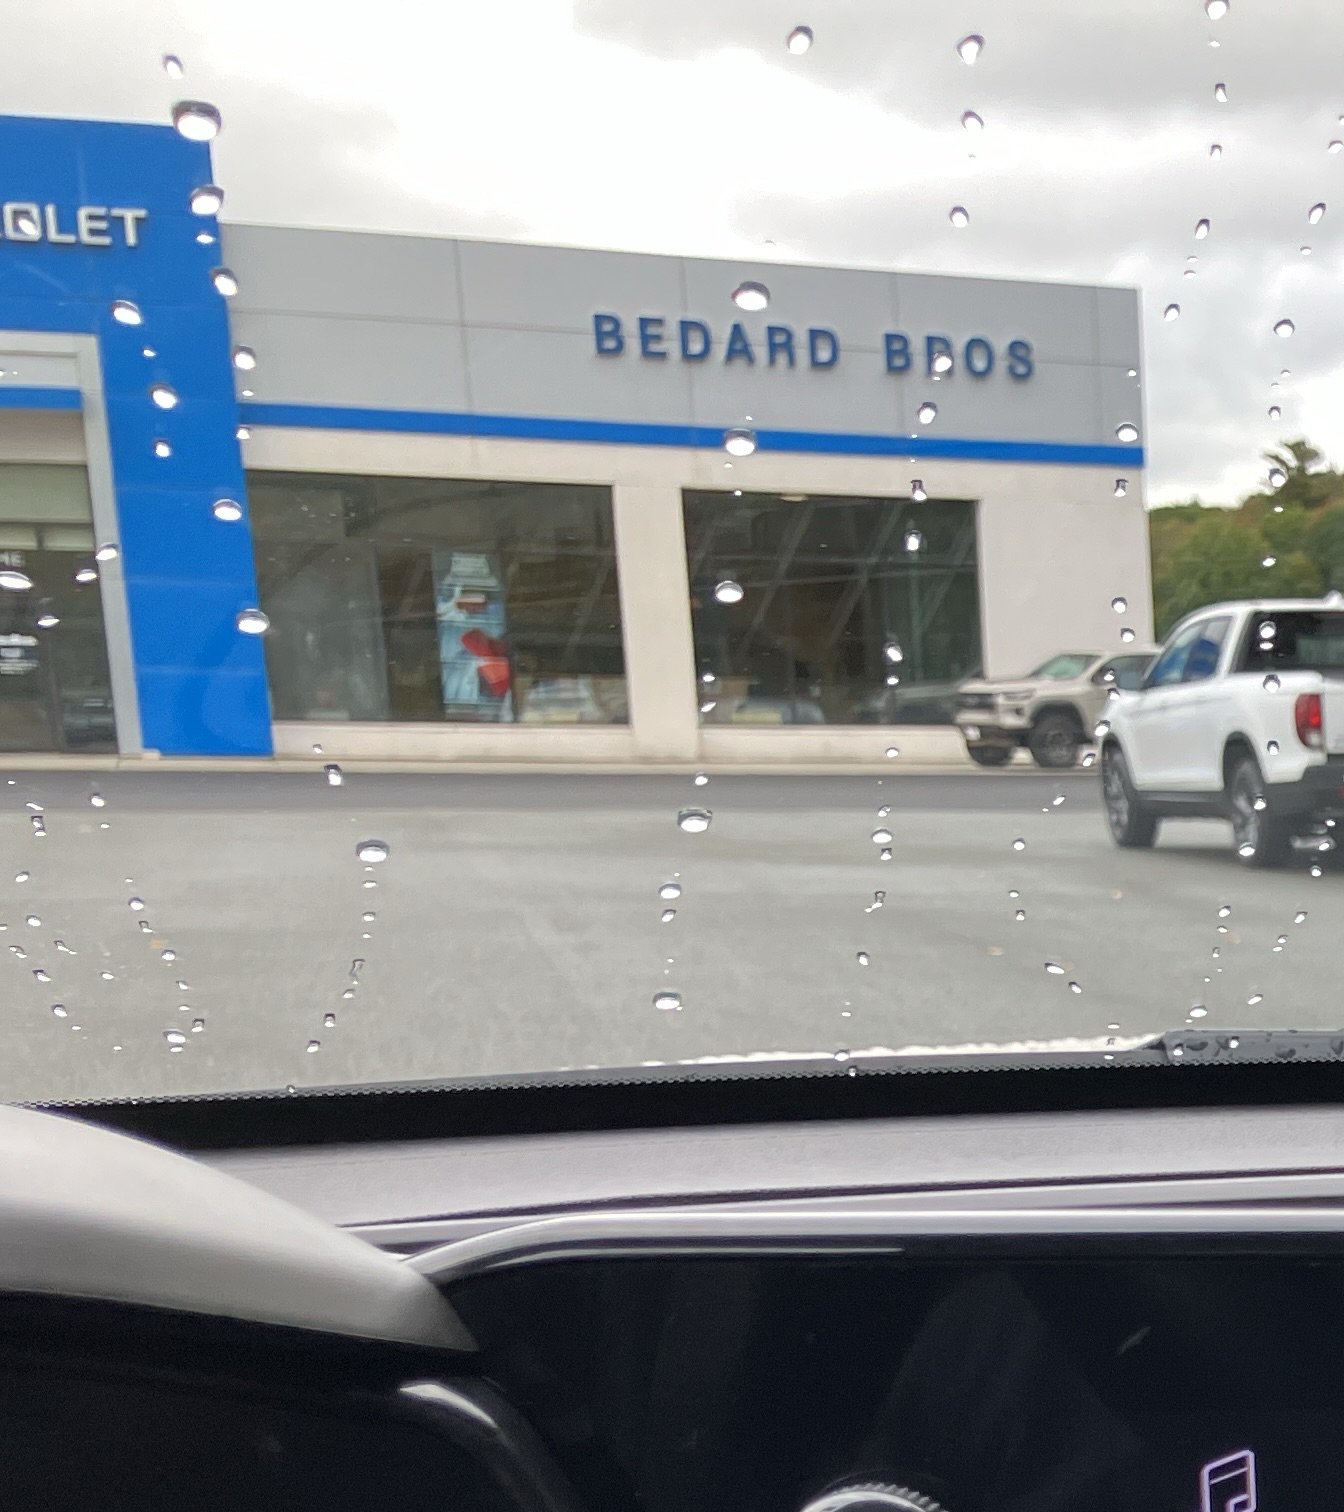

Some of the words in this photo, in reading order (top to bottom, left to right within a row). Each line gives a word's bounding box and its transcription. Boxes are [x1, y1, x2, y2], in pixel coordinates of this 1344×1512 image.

[0, 201, 148, 247] OLET
[593, 314, 841, 371] BEDARD
[884, 331, 1035, 380] BROS
